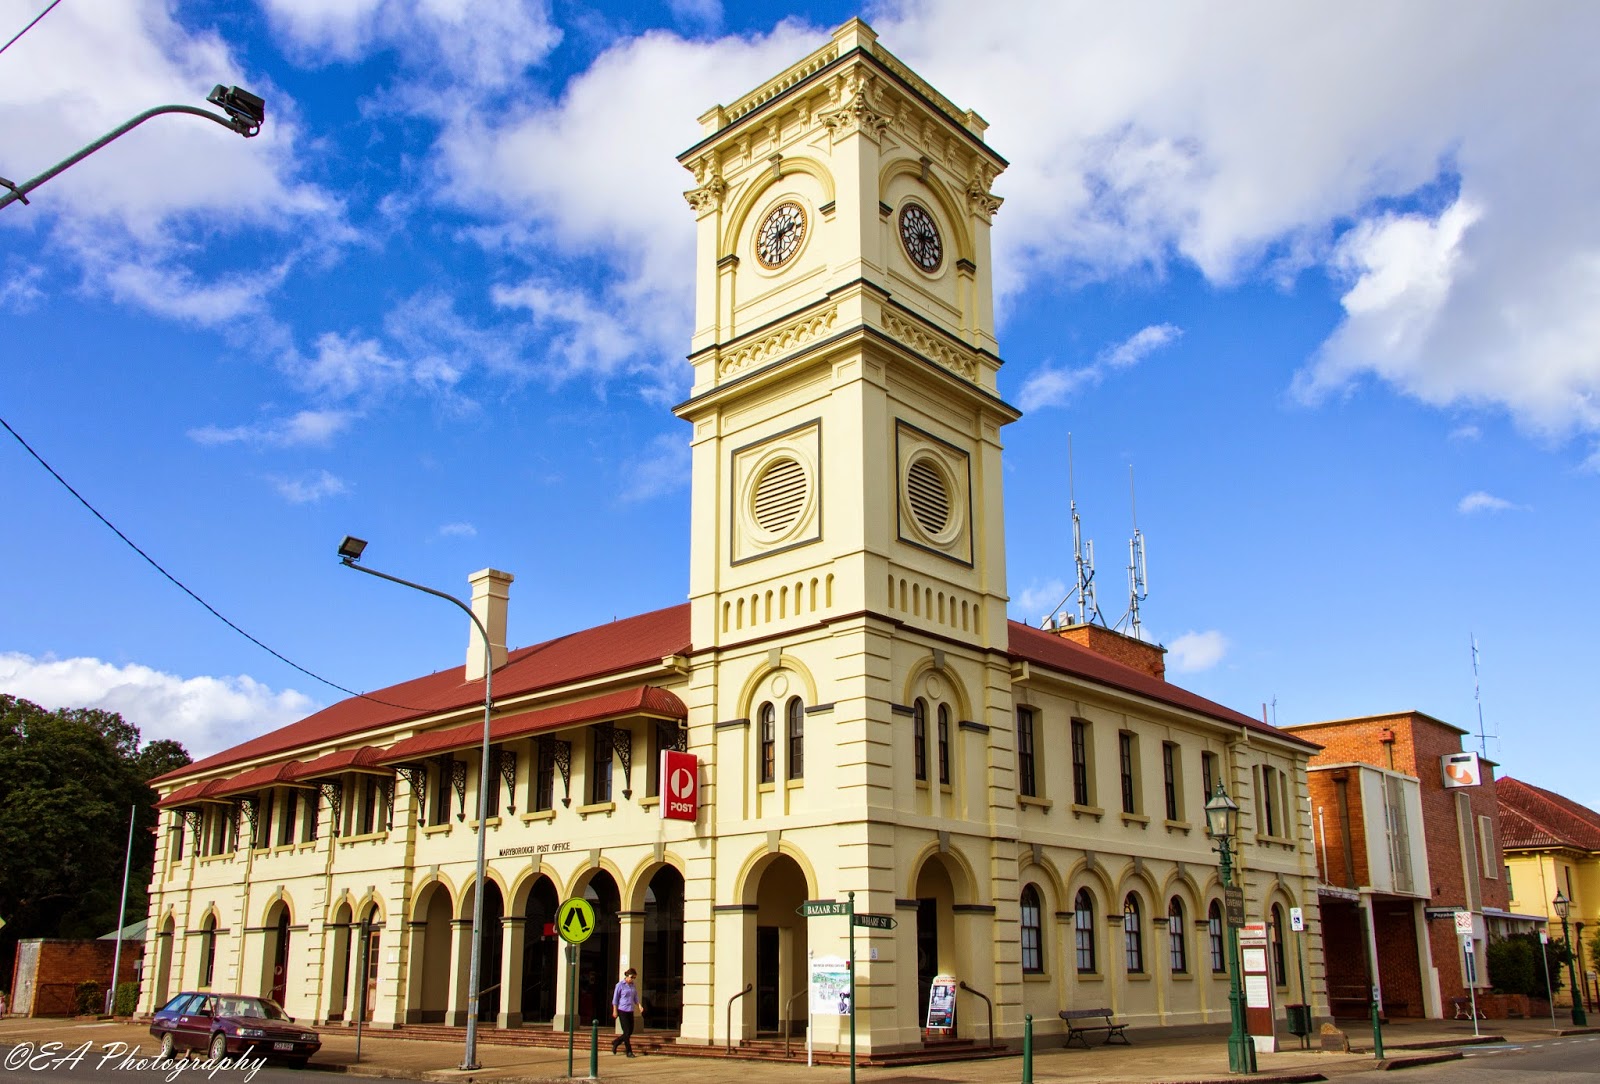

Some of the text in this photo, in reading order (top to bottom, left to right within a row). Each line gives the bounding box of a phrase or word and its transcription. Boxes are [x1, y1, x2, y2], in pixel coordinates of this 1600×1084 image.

[671, 801, 693, 813] POST
[498, 842, 571, 857] MARYBOROUGH POST OFFICE
[807, 904, 831, 915] BAZAAR
[832, 904, 841, 913] ST
[861, 916, 880, 927] WHARF
[880, 918, 888, 927] ST
